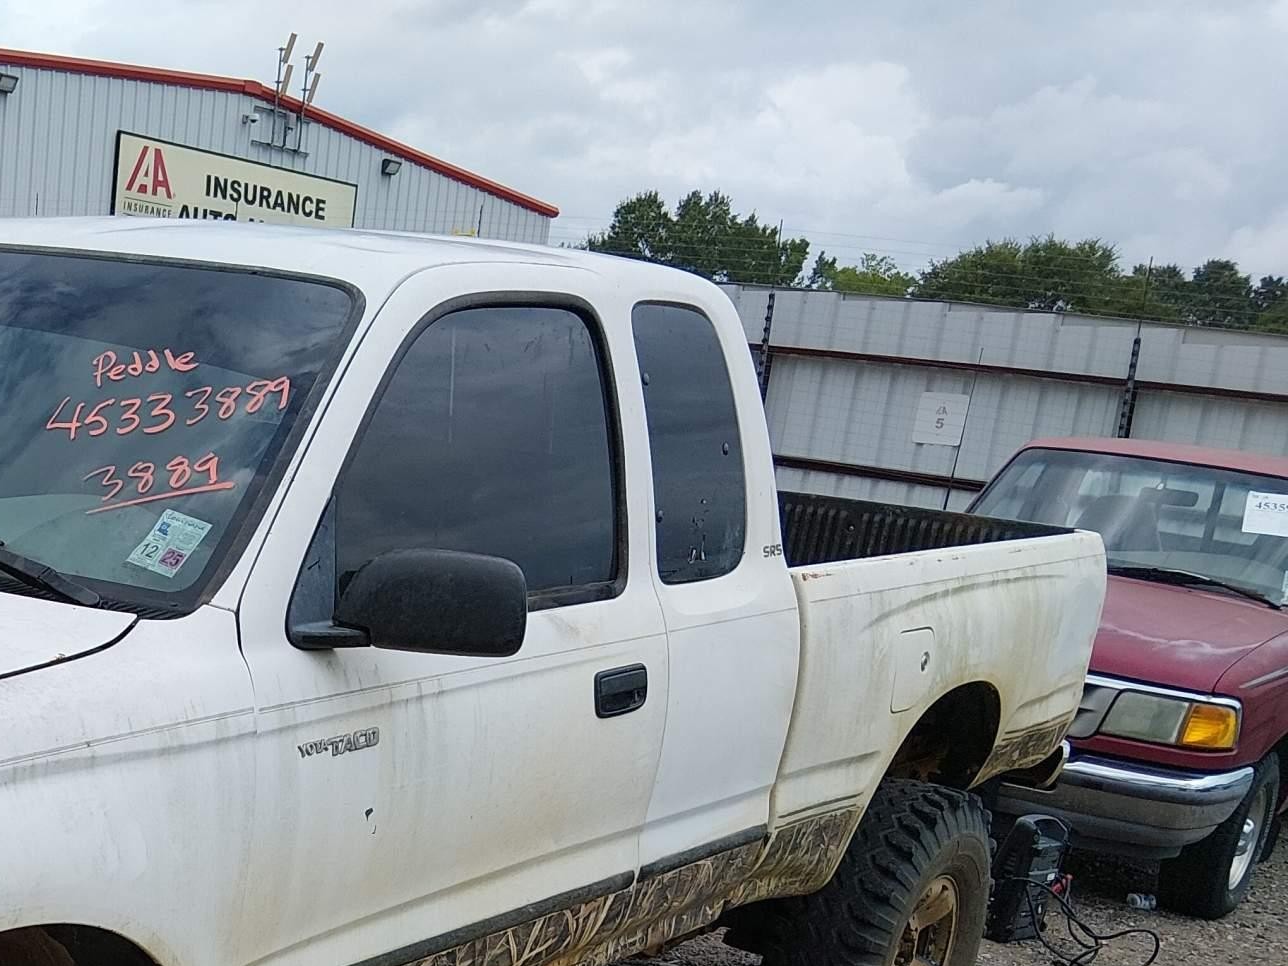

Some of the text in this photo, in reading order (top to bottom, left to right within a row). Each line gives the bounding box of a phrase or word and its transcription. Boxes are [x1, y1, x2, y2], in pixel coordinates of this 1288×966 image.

[205, 174, 327, 221] INSURANCE
[123, 201, 172, 219] INSURANCE
[92, 349, 199, 387] Peddle
[46, 375, 291, 440] 45333889
[935, 417, 945, 429] 5
[82, 452, 220, 502] 3889
[1255, 501, 1288, 513] 4535
[140, 542, 159, 558] 12
[159, 551, 184, 567] 25
